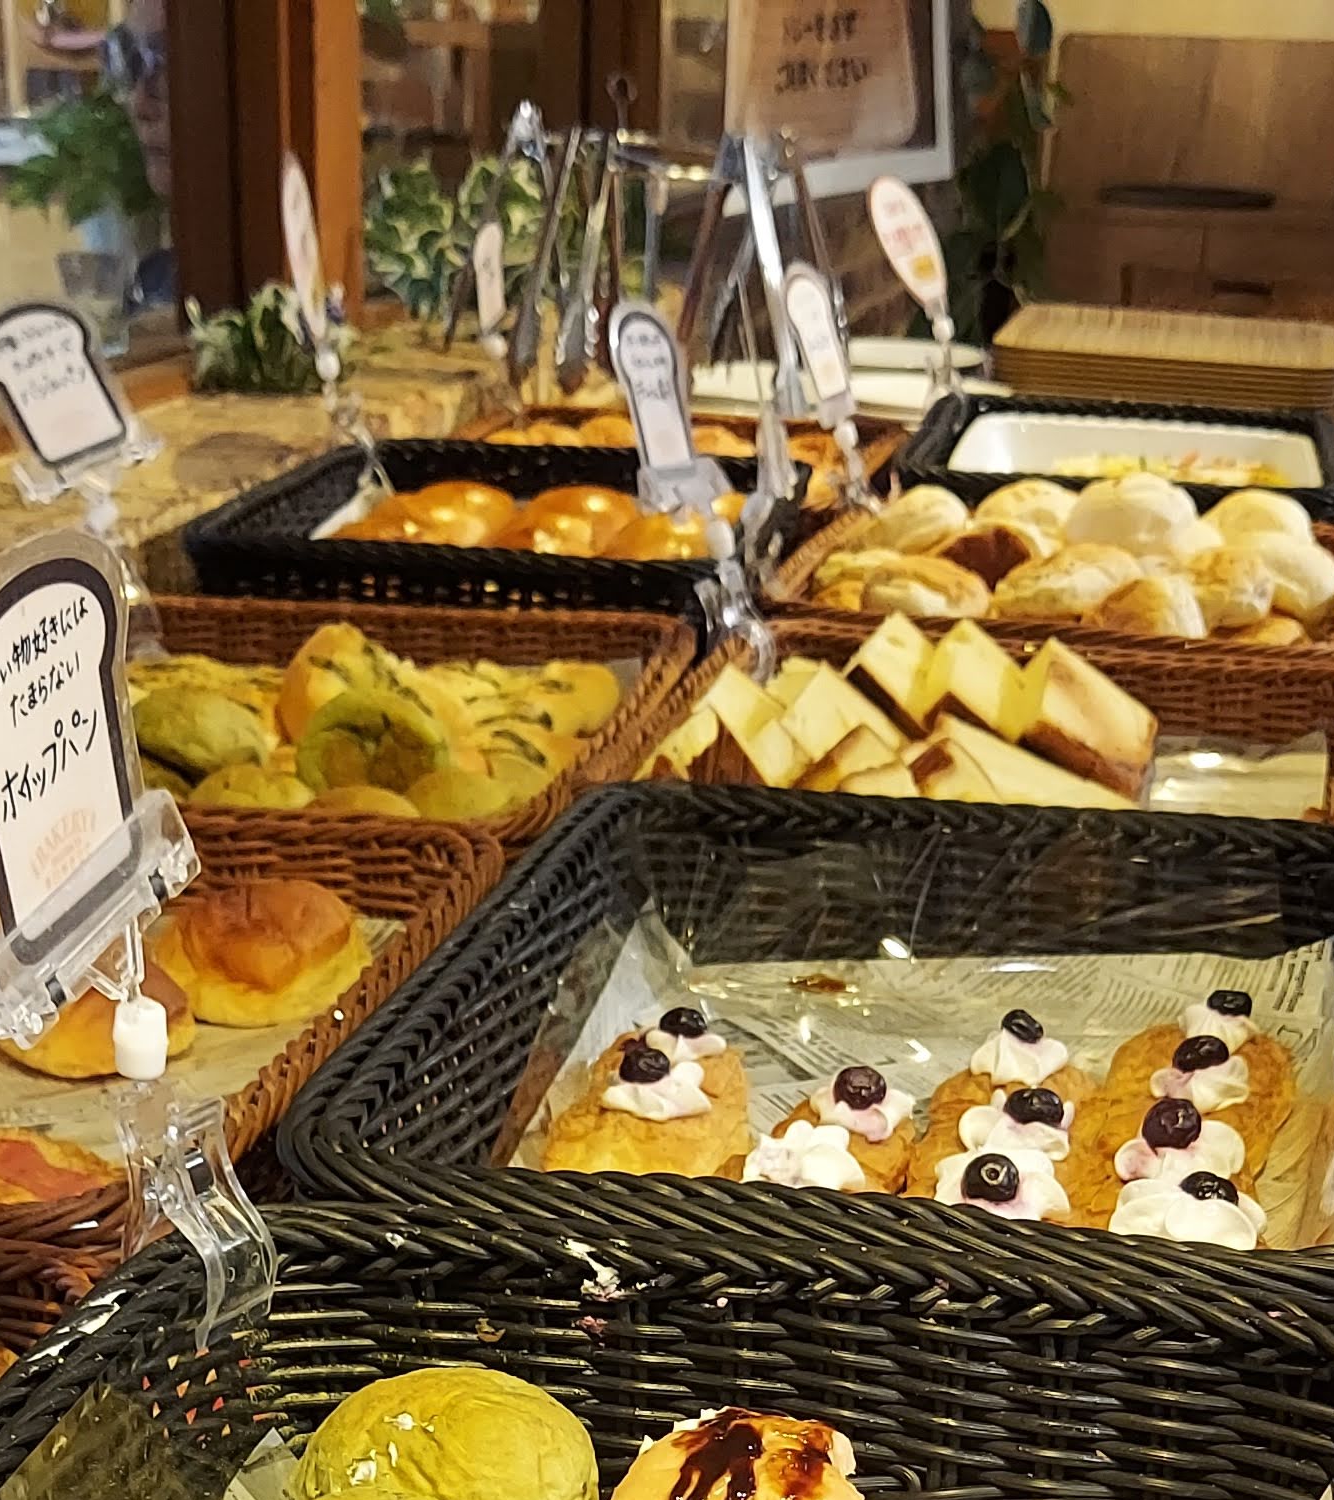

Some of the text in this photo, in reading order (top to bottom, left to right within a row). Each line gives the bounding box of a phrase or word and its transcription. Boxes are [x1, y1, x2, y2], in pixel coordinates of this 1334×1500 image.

[0, 709, 97, 823] ホイップパン
